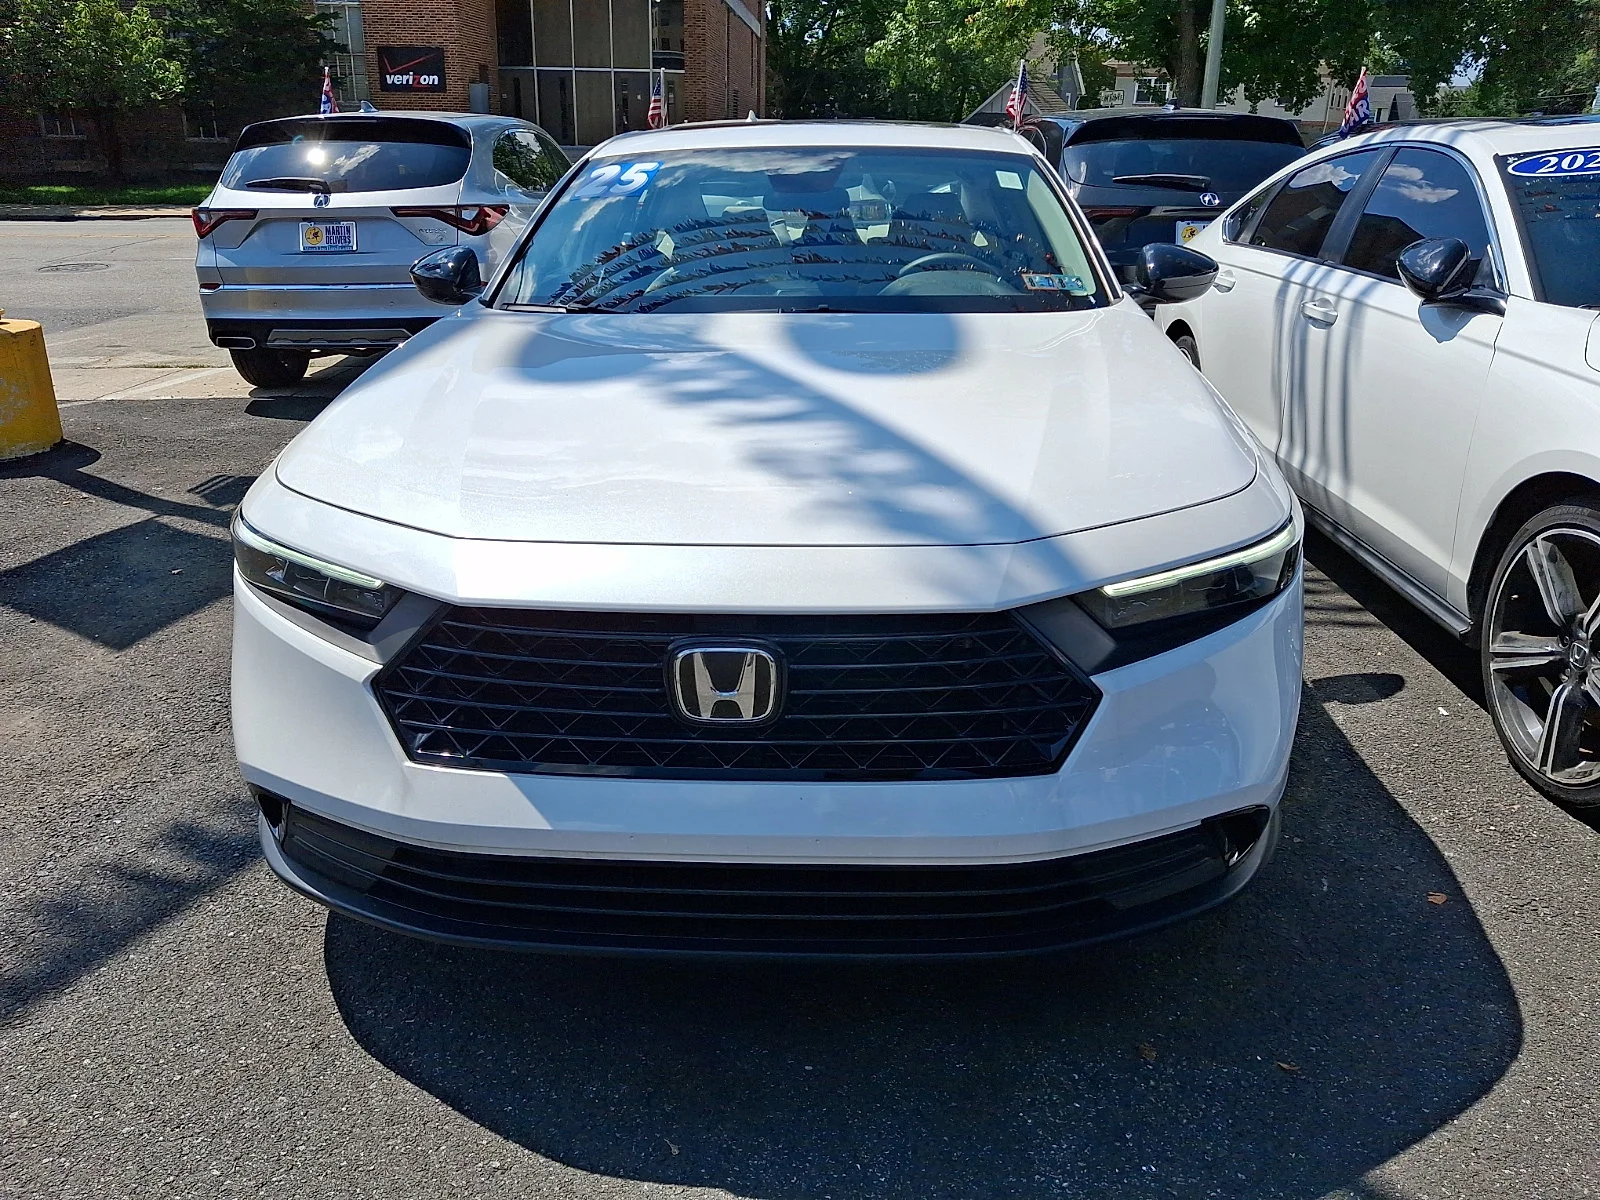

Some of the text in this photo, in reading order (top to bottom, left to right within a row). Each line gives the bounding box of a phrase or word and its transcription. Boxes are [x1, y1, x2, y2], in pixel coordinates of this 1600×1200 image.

[386, 72, 439, 88] verizon
[575, 162, 660, 197] 25
[325, 225, 351, 236] MARTIN
[325, 236, 352, 245] DELIVERS
